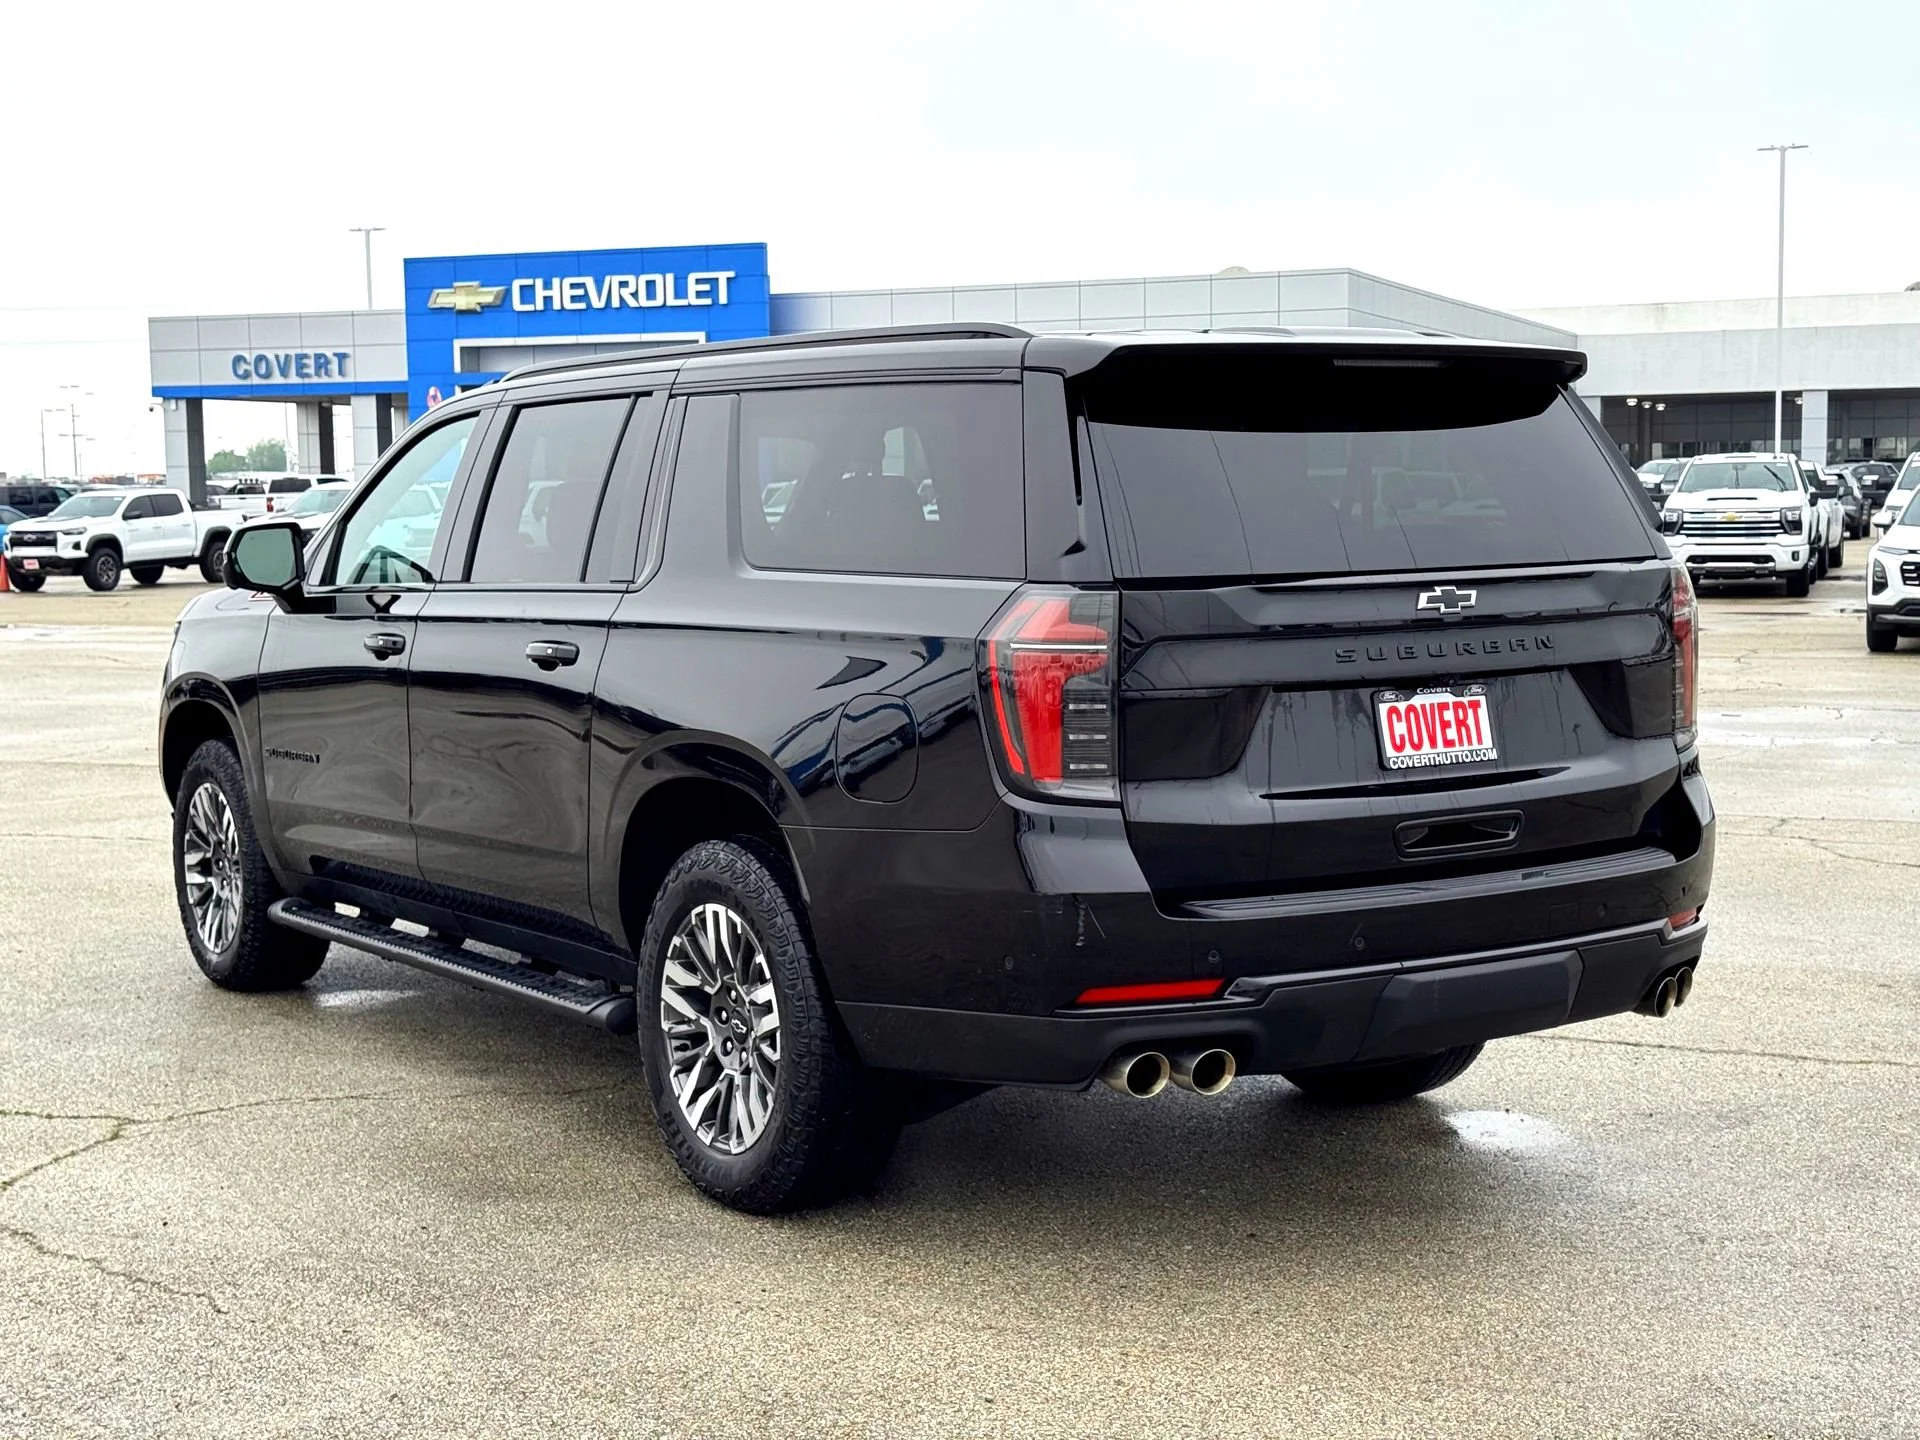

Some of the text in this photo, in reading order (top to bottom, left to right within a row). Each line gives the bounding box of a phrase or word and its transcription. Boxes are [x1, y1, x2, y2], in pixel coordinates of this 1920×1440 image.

[511, 270, 736, 312] CHEVROLET
[232, 352, 351, 380] COVERT
[1335, 636, 1555, 663] SUBURBAN
[1386, 700, 1483, 753] COVERT
[1389, 748, 1498, 769] COVERTHUTTO.COM
